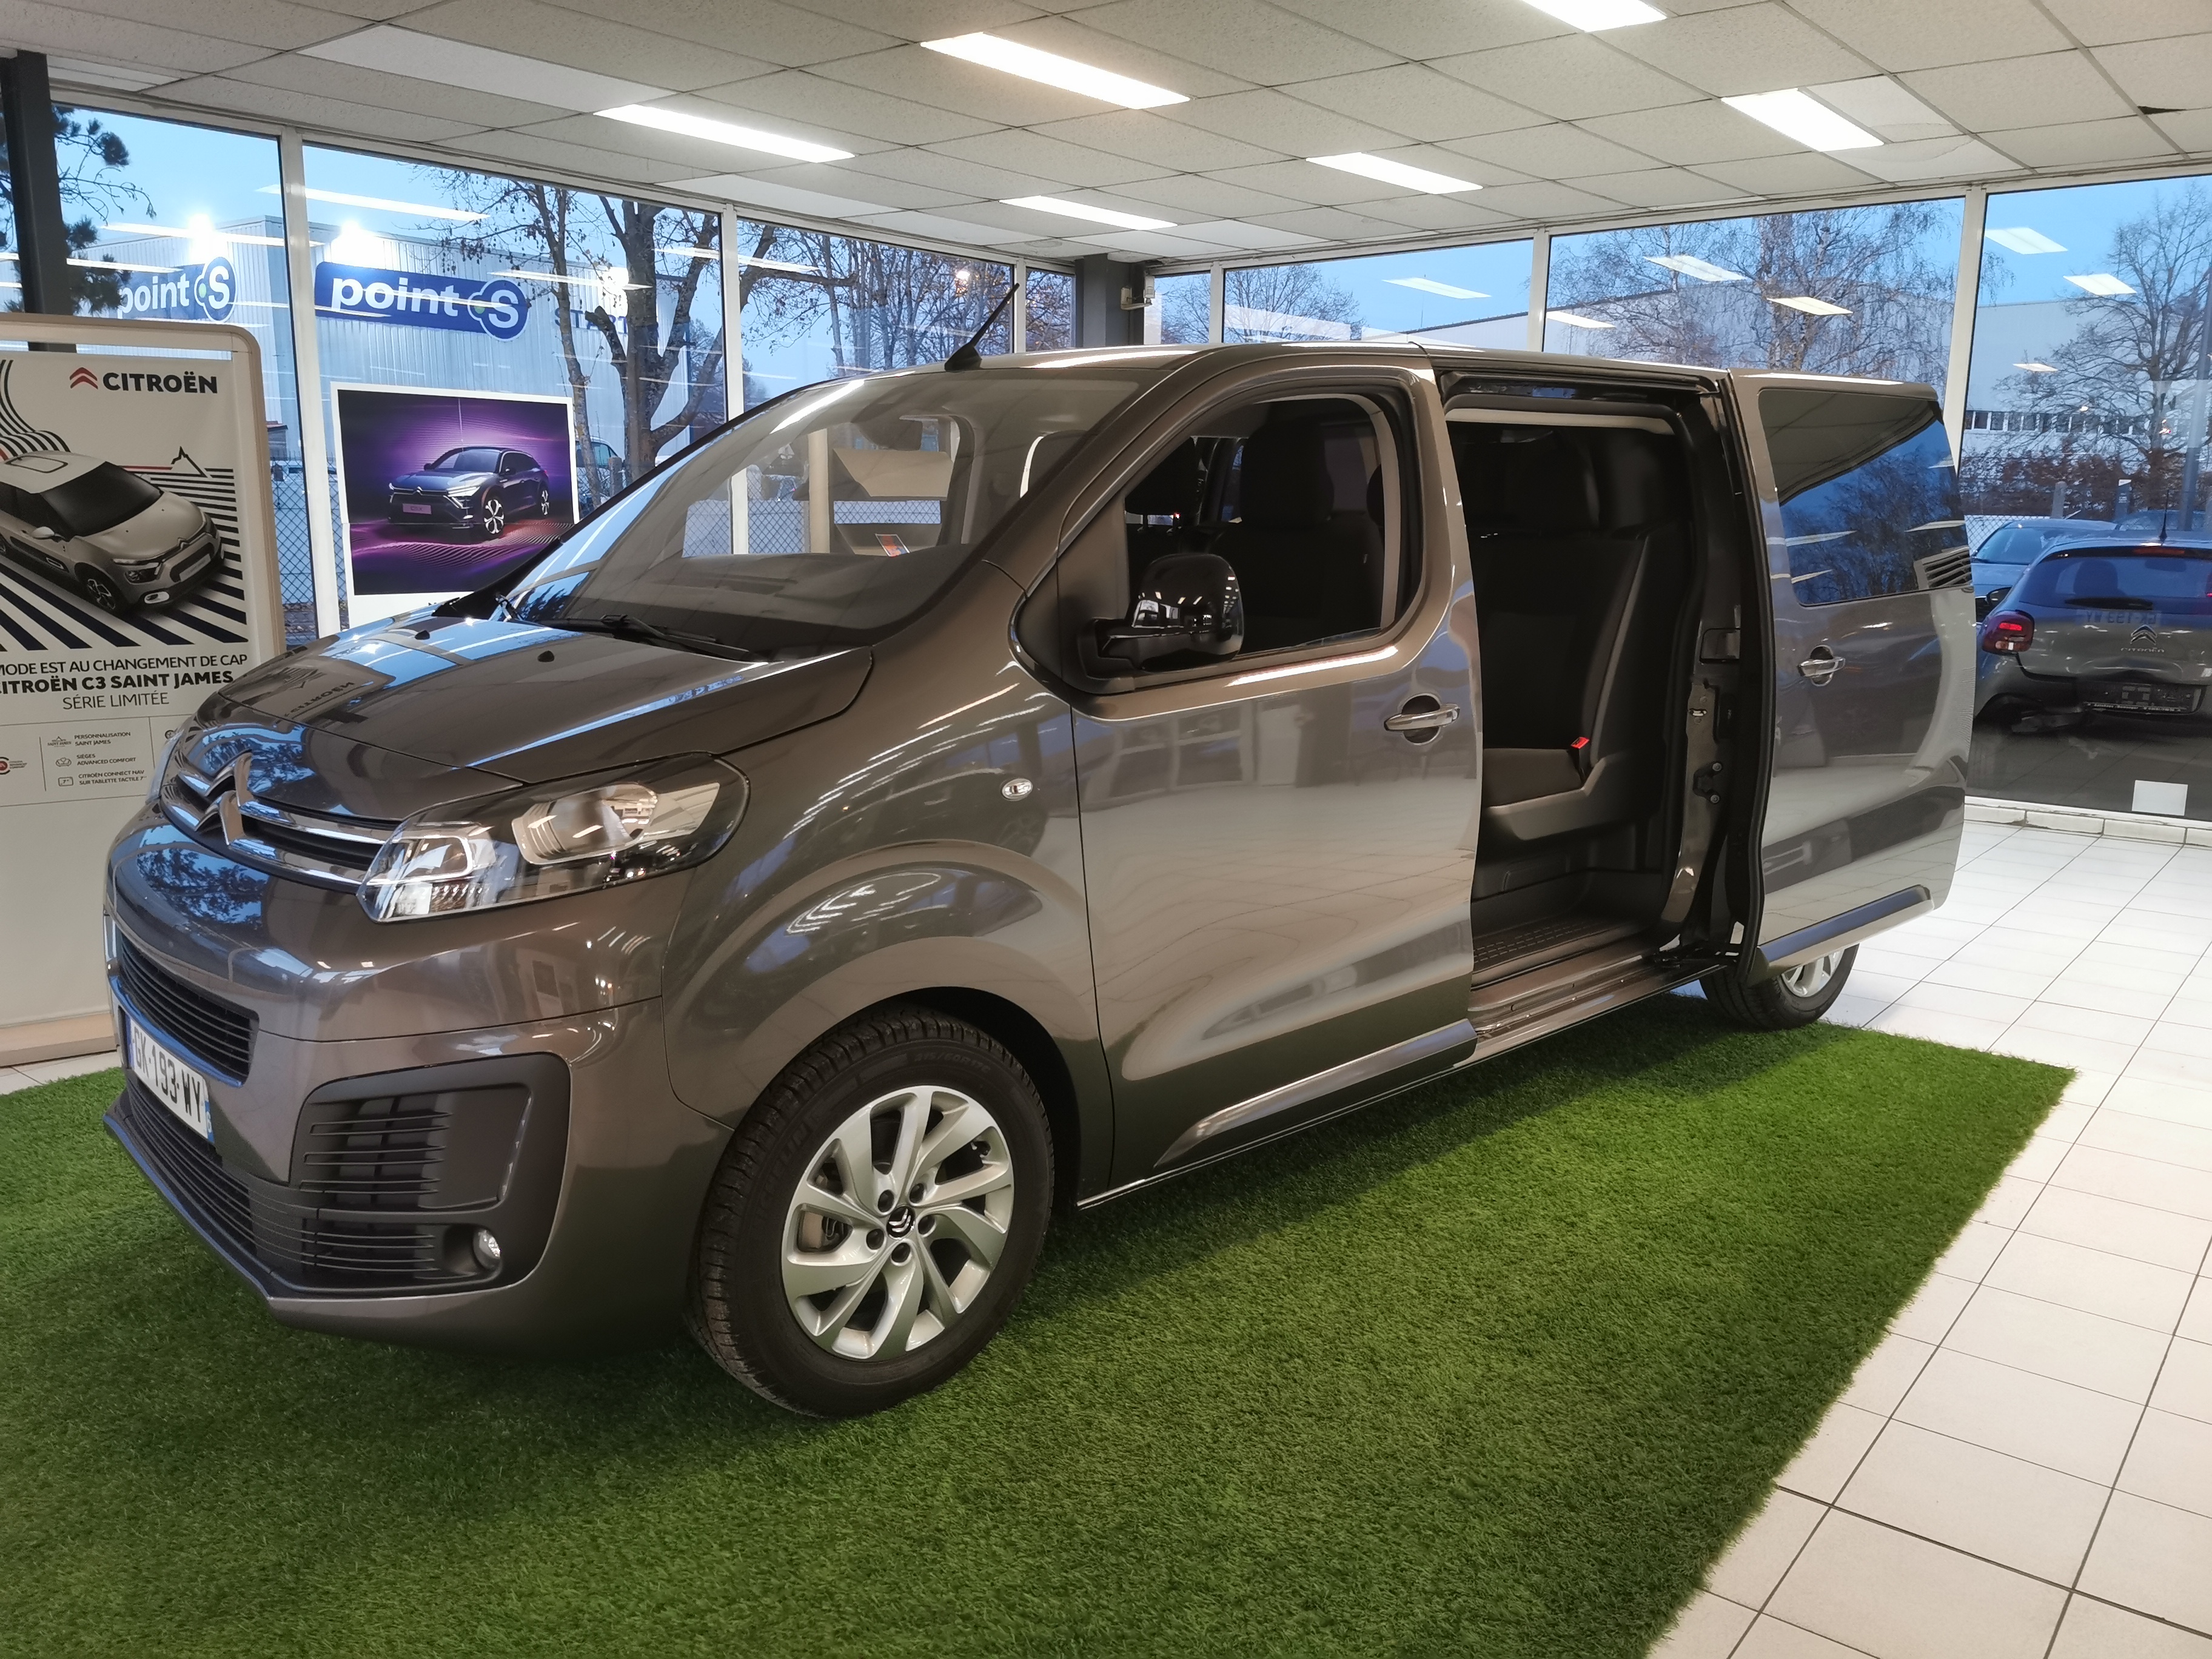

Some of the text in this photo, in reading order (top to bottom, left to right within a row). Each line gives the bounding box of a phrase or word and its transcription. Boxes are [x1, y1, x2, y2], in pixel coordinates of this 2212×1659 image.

[118, 273, 190, 319] point
[332, 276, 460, 317] point
[102, 370, 218, 394] CITROËN
[40, 661, 66, 674] EST
[69, 660, 90, 672] AU
[93, 655, 198, 671] CHANGEMENT
[200, 655, 218, 666] DE
[220, 654, 248, 666] CAP
[0, 671, 234, 694] ITROËN C3 SAINT JAMES
[62, 689, 170, 710] SÉRIE LIMITÉE
[74, 731, 131, 740] PERSONNALISATION
